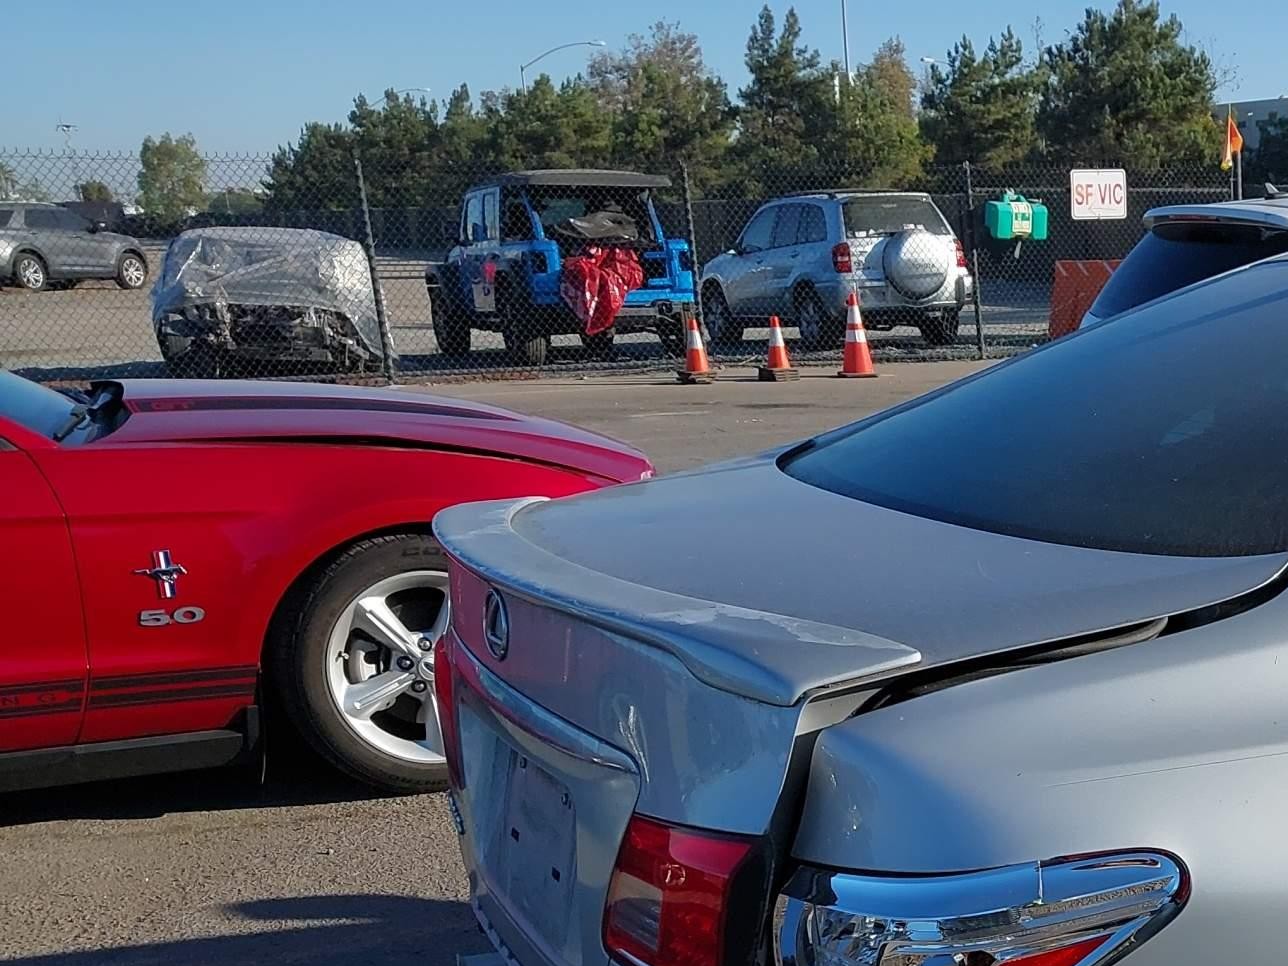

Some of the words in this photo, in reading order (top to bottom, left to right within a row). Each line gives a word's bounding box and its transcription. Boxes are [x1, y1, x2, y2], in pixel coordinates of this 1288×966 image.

[1075, 184, 1093, 205] SF
[1098, 184, 1123, 205] VIC
[140, 606, 205, 626] 5.0
